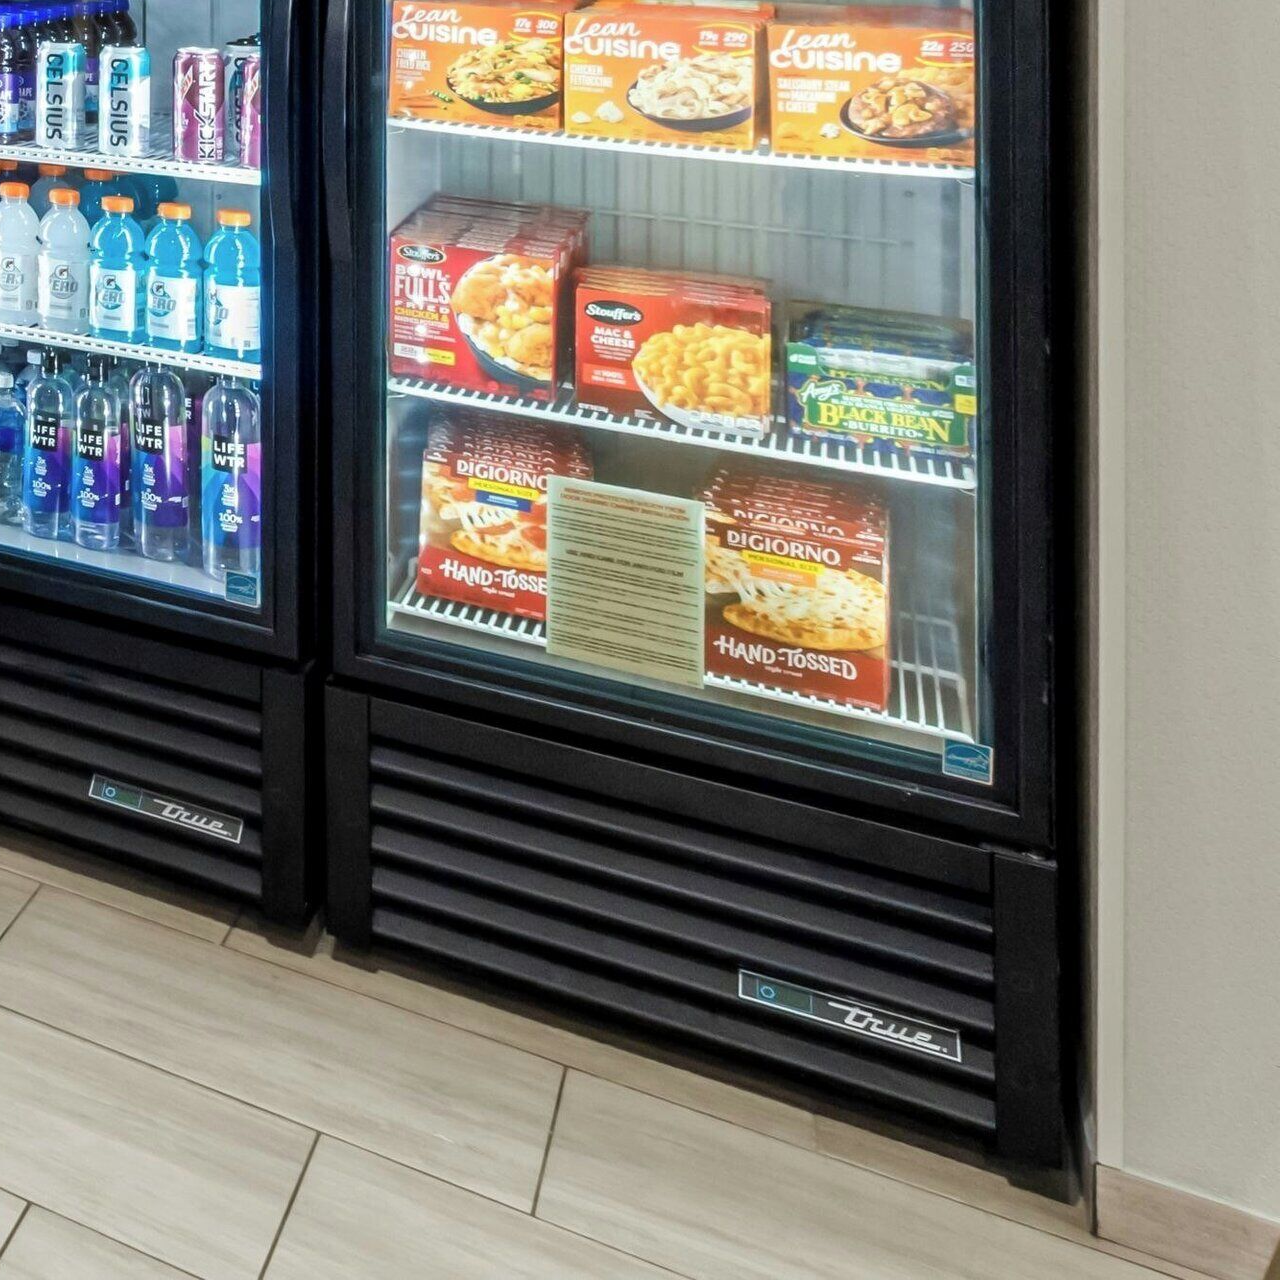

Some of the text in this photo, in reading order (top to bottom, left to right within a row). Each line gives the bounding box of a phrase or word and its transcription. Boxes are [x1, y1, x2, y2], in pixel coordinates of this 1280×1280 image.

[400, 4, 462, 25] Lean
[536, 20, 558, 30] 300
[573, 17, 641, 40] Lean
[724, 32, 747, 43] 290
[778, 29, 856, 53] Lean
[45, 53, 65, 141] CELSIUS
[109, 58, 129, 148] CELSIUS
[394, 275, 451, 305] FULLS
[585, 303, 642, 322] Stouffer's
[594, 326, 632, 338] MAC &
[590, 335, 635, 349] CHEESE
[801, 382, 841, 402] Amy's
[31, 422, 56, 435] LIFE
[137, 421, 162, 435] LIFE
[817, 402, 888, 426] BLACK
[891, 412, 952, 443] BEAN
[847, 421, 918, 439] BURRITO
[31, 435, 56, 447] WTR
[78, 431, 103, 445] LIFE
[137, 436, 163, 450] WTR
[78, 445, 103, 457] WTR
[214, 440, 245, 455] LIFE
[214, 455, 245, 468] WTR
[726, 529, 841, 566] DIGIORNO
[439, 558, 548, 596] HAND-TOSSE
[713, 634, 857, 680] HAND-TOSSED
